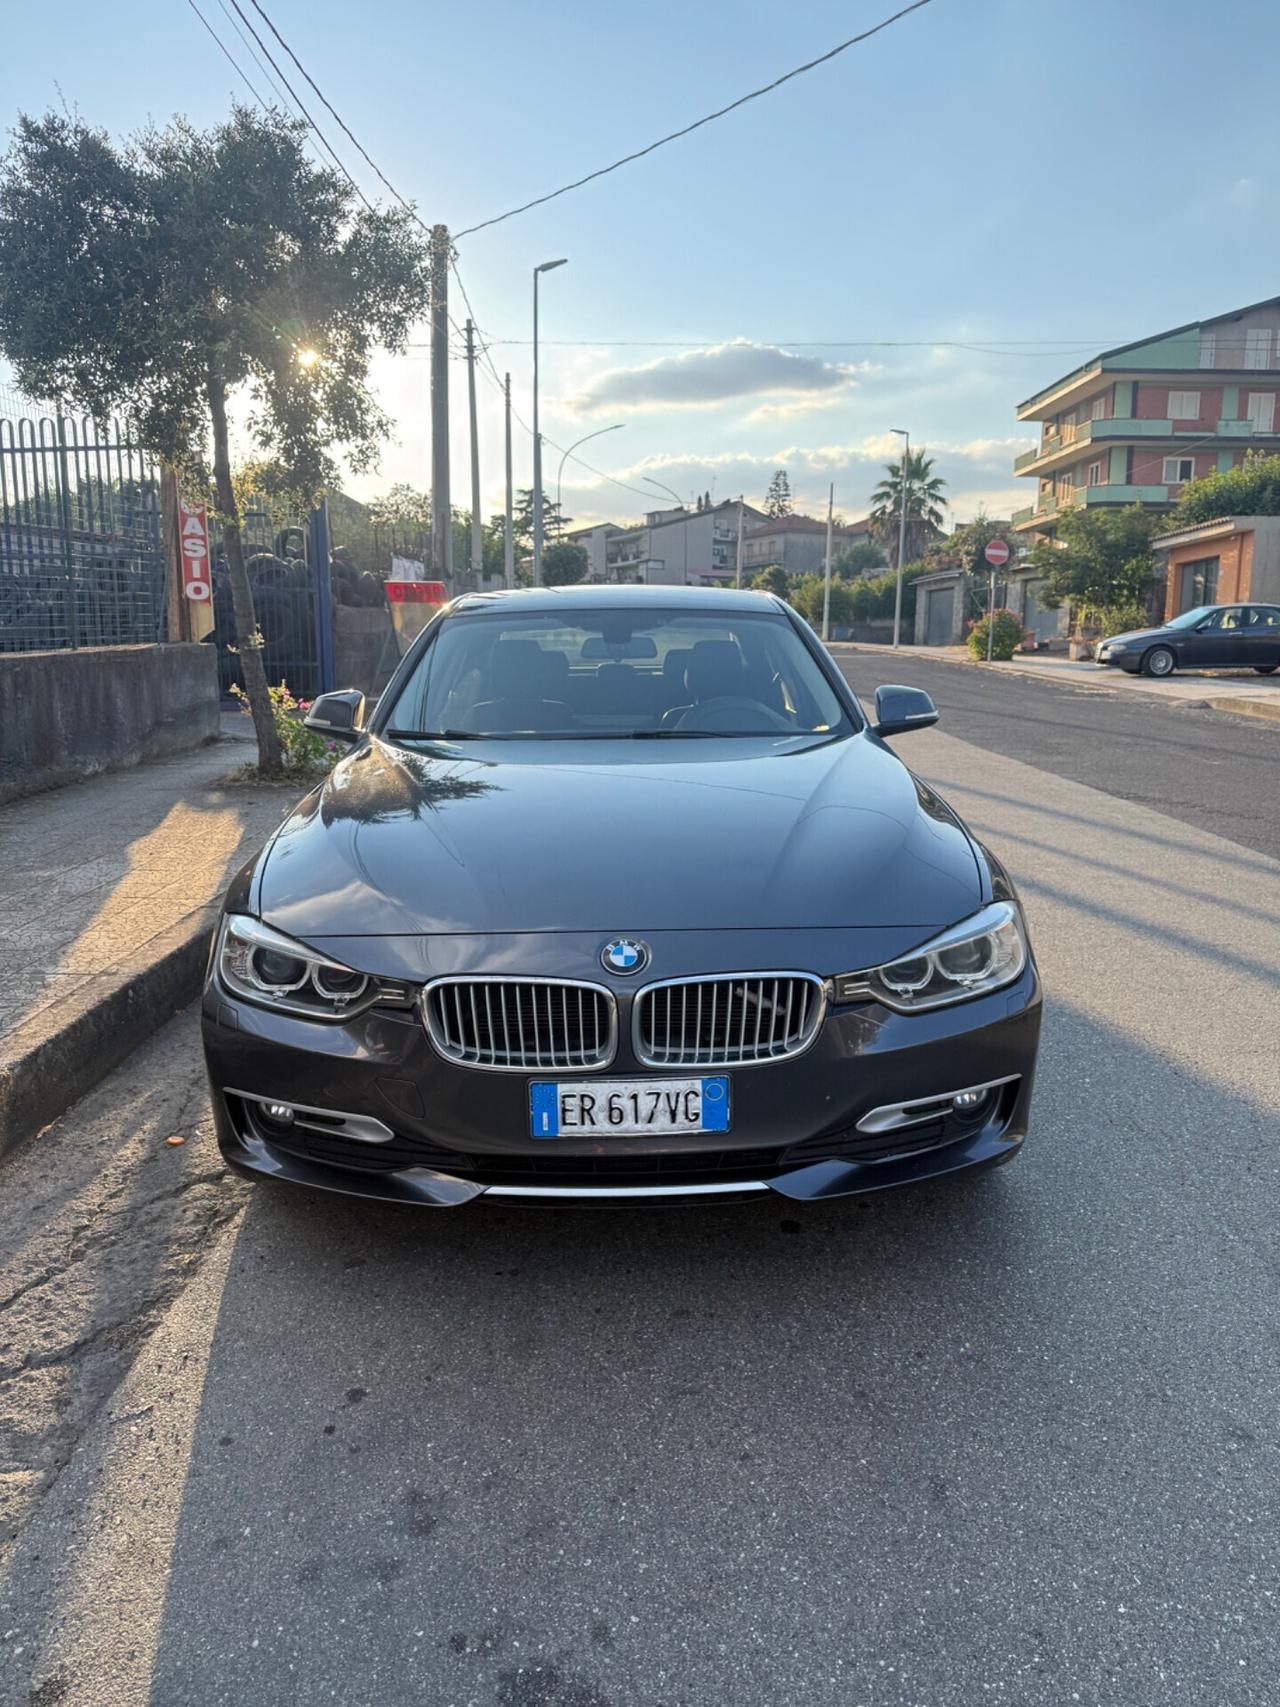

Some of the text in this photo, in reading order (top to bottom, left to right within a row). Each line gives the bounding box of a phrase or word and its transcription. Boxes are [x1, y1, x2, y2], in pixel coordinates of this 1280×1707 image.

[606, 939, 641, 951] BMW
[561, 1090, 700, 1127] ER 617VG
